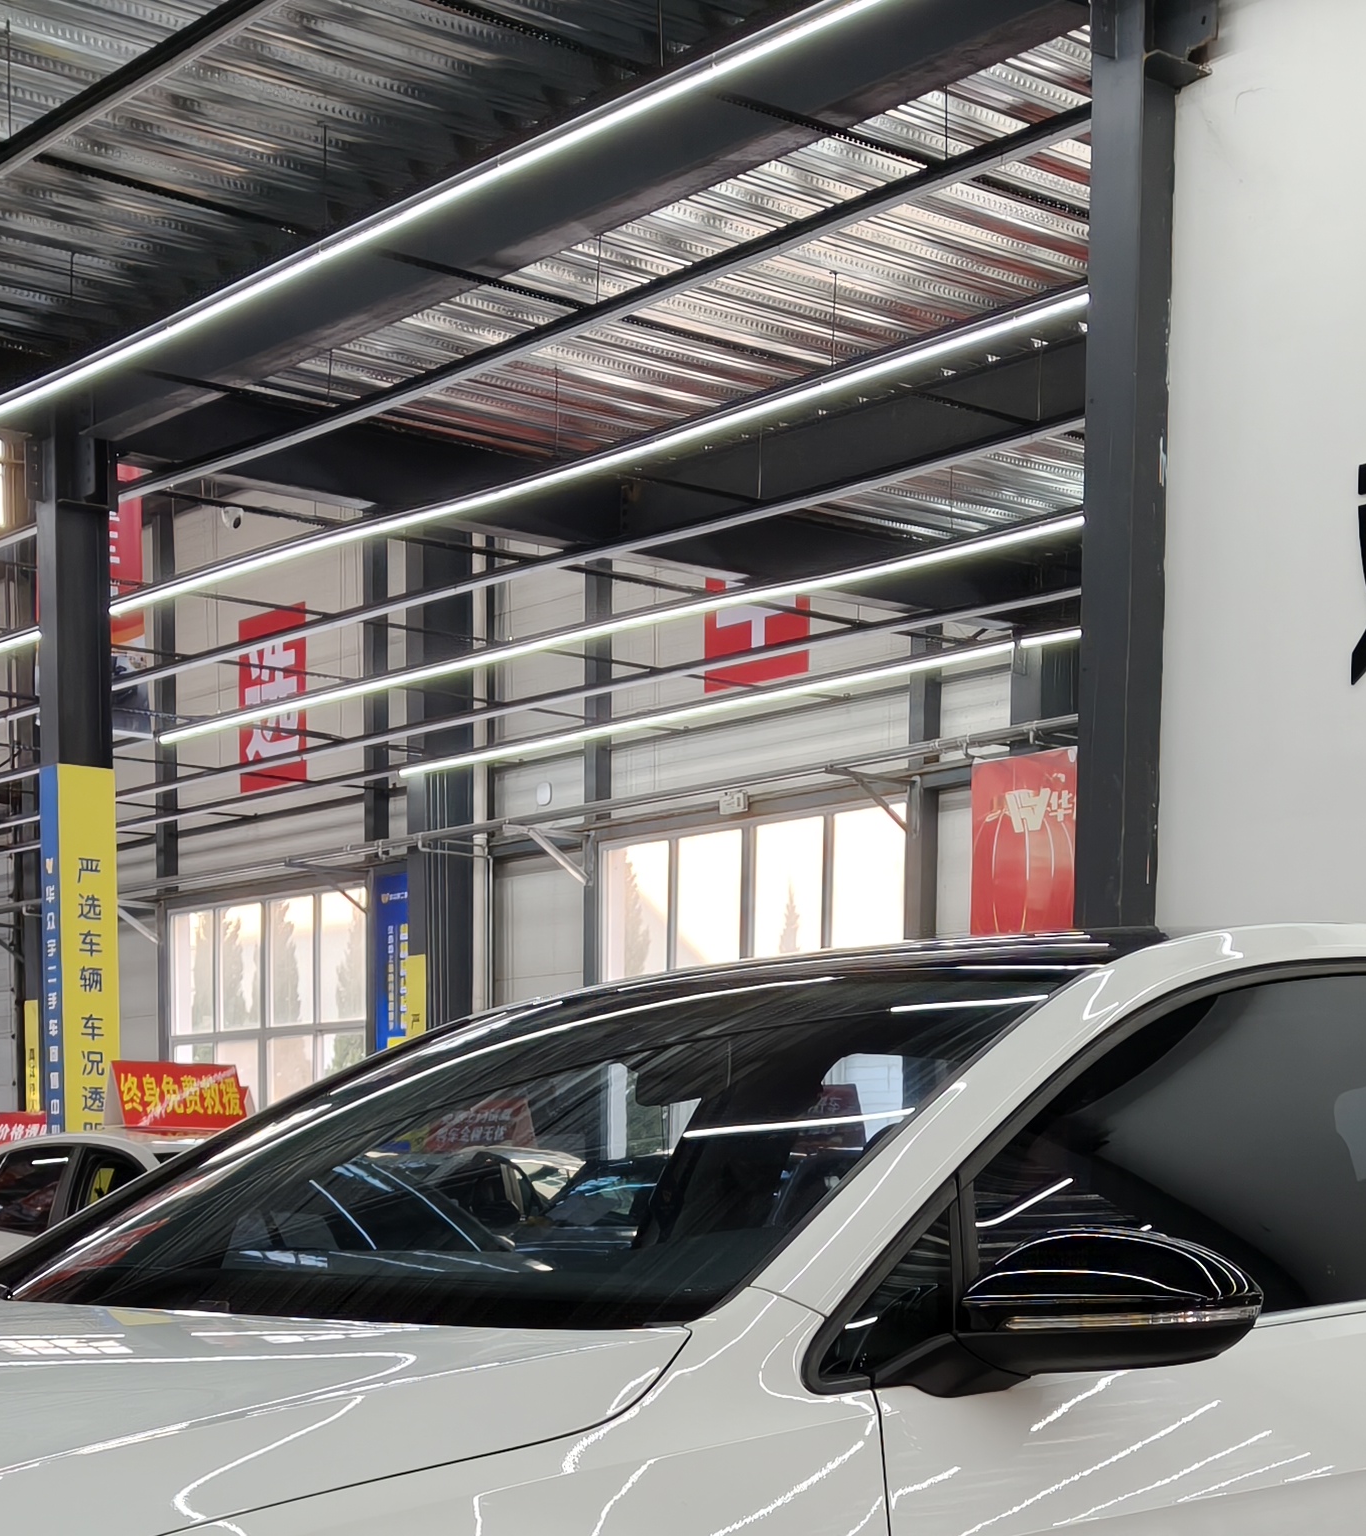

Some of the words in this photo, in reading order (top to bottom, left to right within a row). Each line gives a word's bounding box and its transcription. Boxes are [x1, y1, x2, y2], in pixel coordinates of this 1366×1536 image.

[77, 857, 103, 993] 严选车辆
[120, 1073, 243, 1116] 终身免费救援
